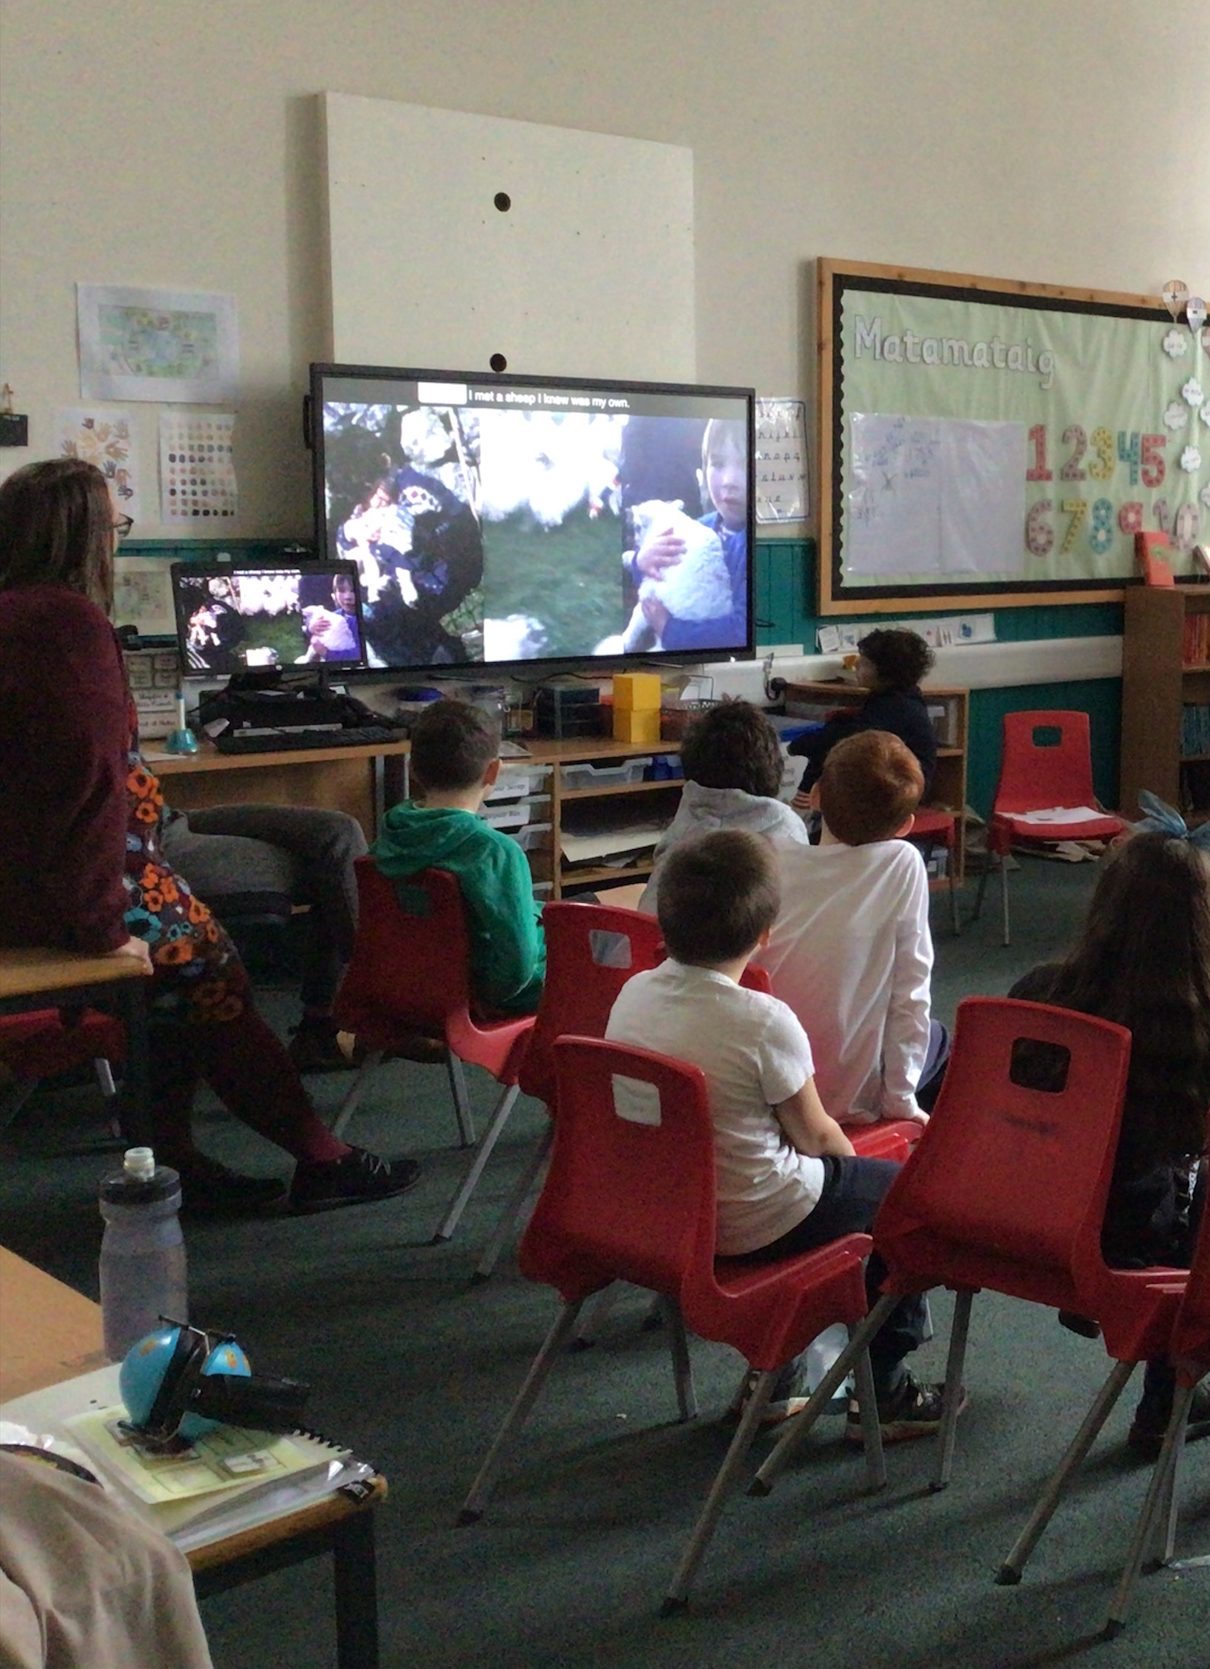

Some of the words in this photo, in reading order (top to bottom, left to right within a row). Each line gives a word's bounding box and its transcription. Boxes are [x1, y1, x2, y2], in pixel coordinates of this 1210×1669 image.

[855, 315, 1056, 389] Matamataig
[468, 389, 473, 401] I
[474, 391, 495, 402] met
[496, 393, 504, 402] a
[505, 391, 536, 406] sheep
[537, 393, 542, 404] I
[570, 396, 591, 407] was
[592, 397, 607, 409] my
[1026, 424, 1053, 481] 1
[1060, 425, 1088, 481] 2
[1088, 425, 1116, 481] 3
[1117, 430, 1141, 487] 4
[1141, 433, 1167, 488] 5
[1026, 499, 1054, 557] 6
[1060, 499, 1088, 554] 7
[1089, 498, 1114, 555] 8
